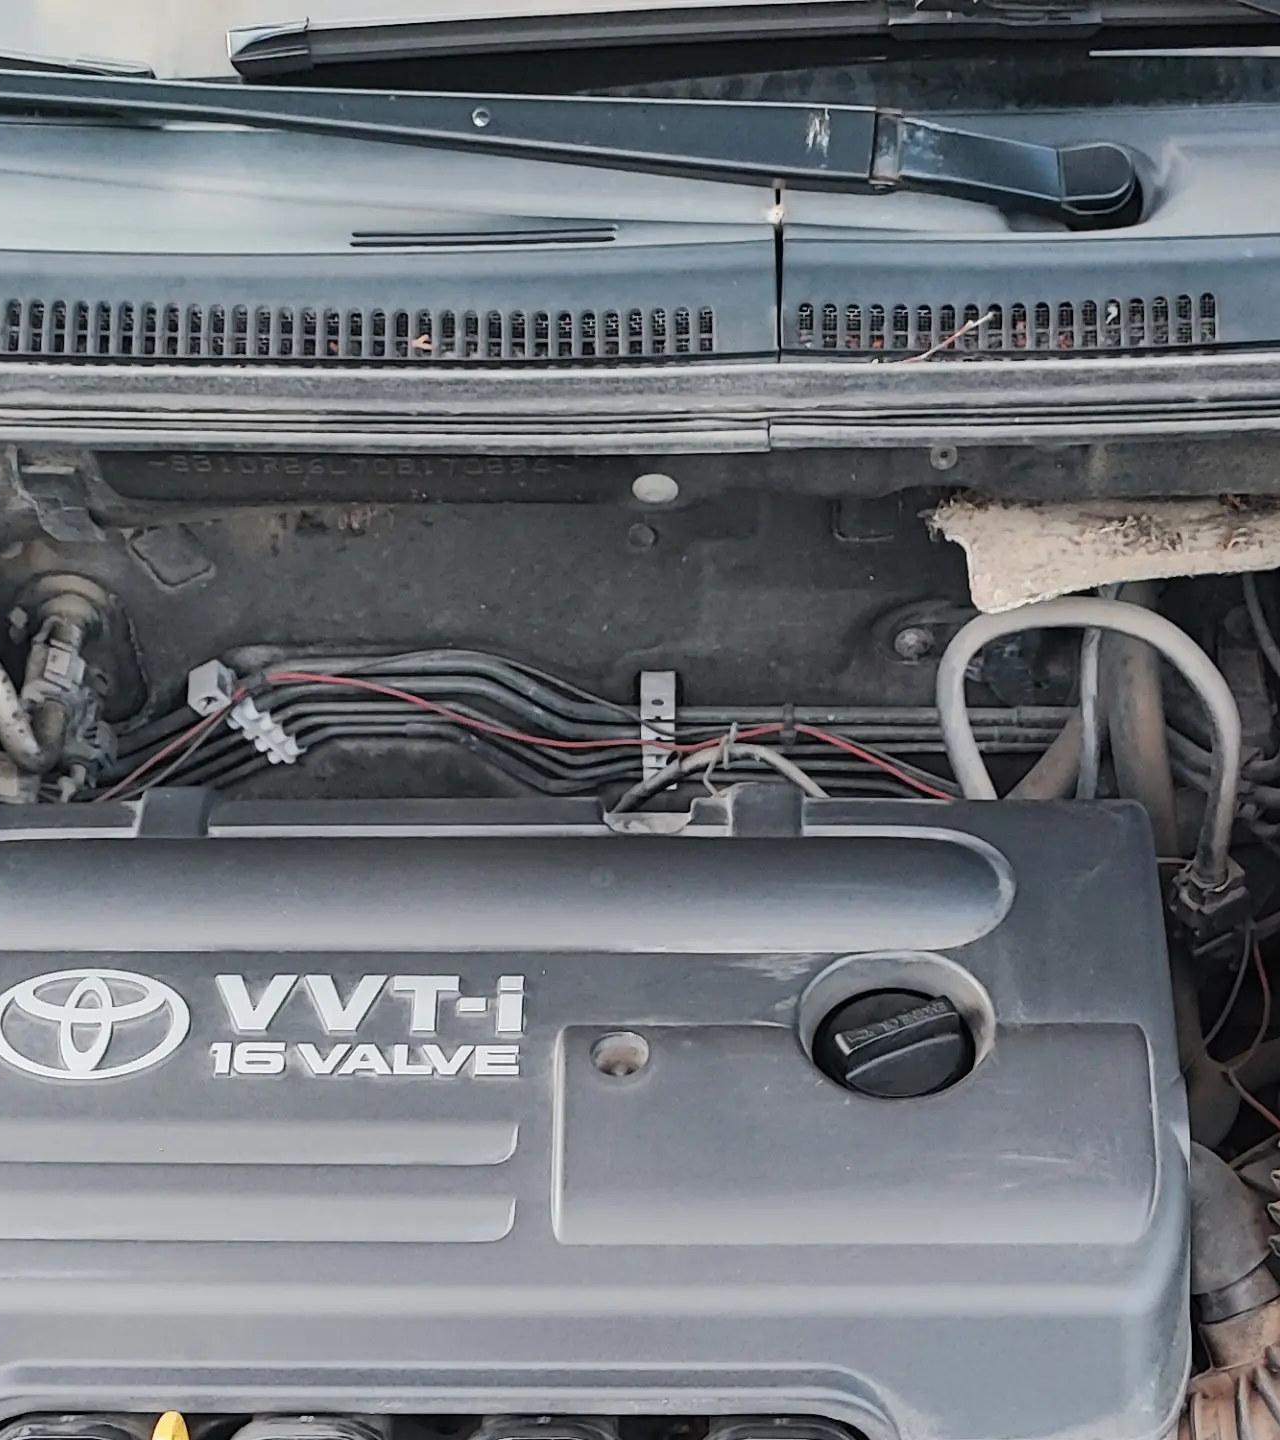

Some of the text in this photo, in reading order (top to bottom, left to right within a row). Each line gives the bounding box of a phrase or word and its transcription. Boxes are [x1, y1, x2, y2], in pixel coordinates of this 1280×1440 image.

[216, 974, 524, 1032] VVT-i
[211, 1042, 520, 1076] 16 VALVE
